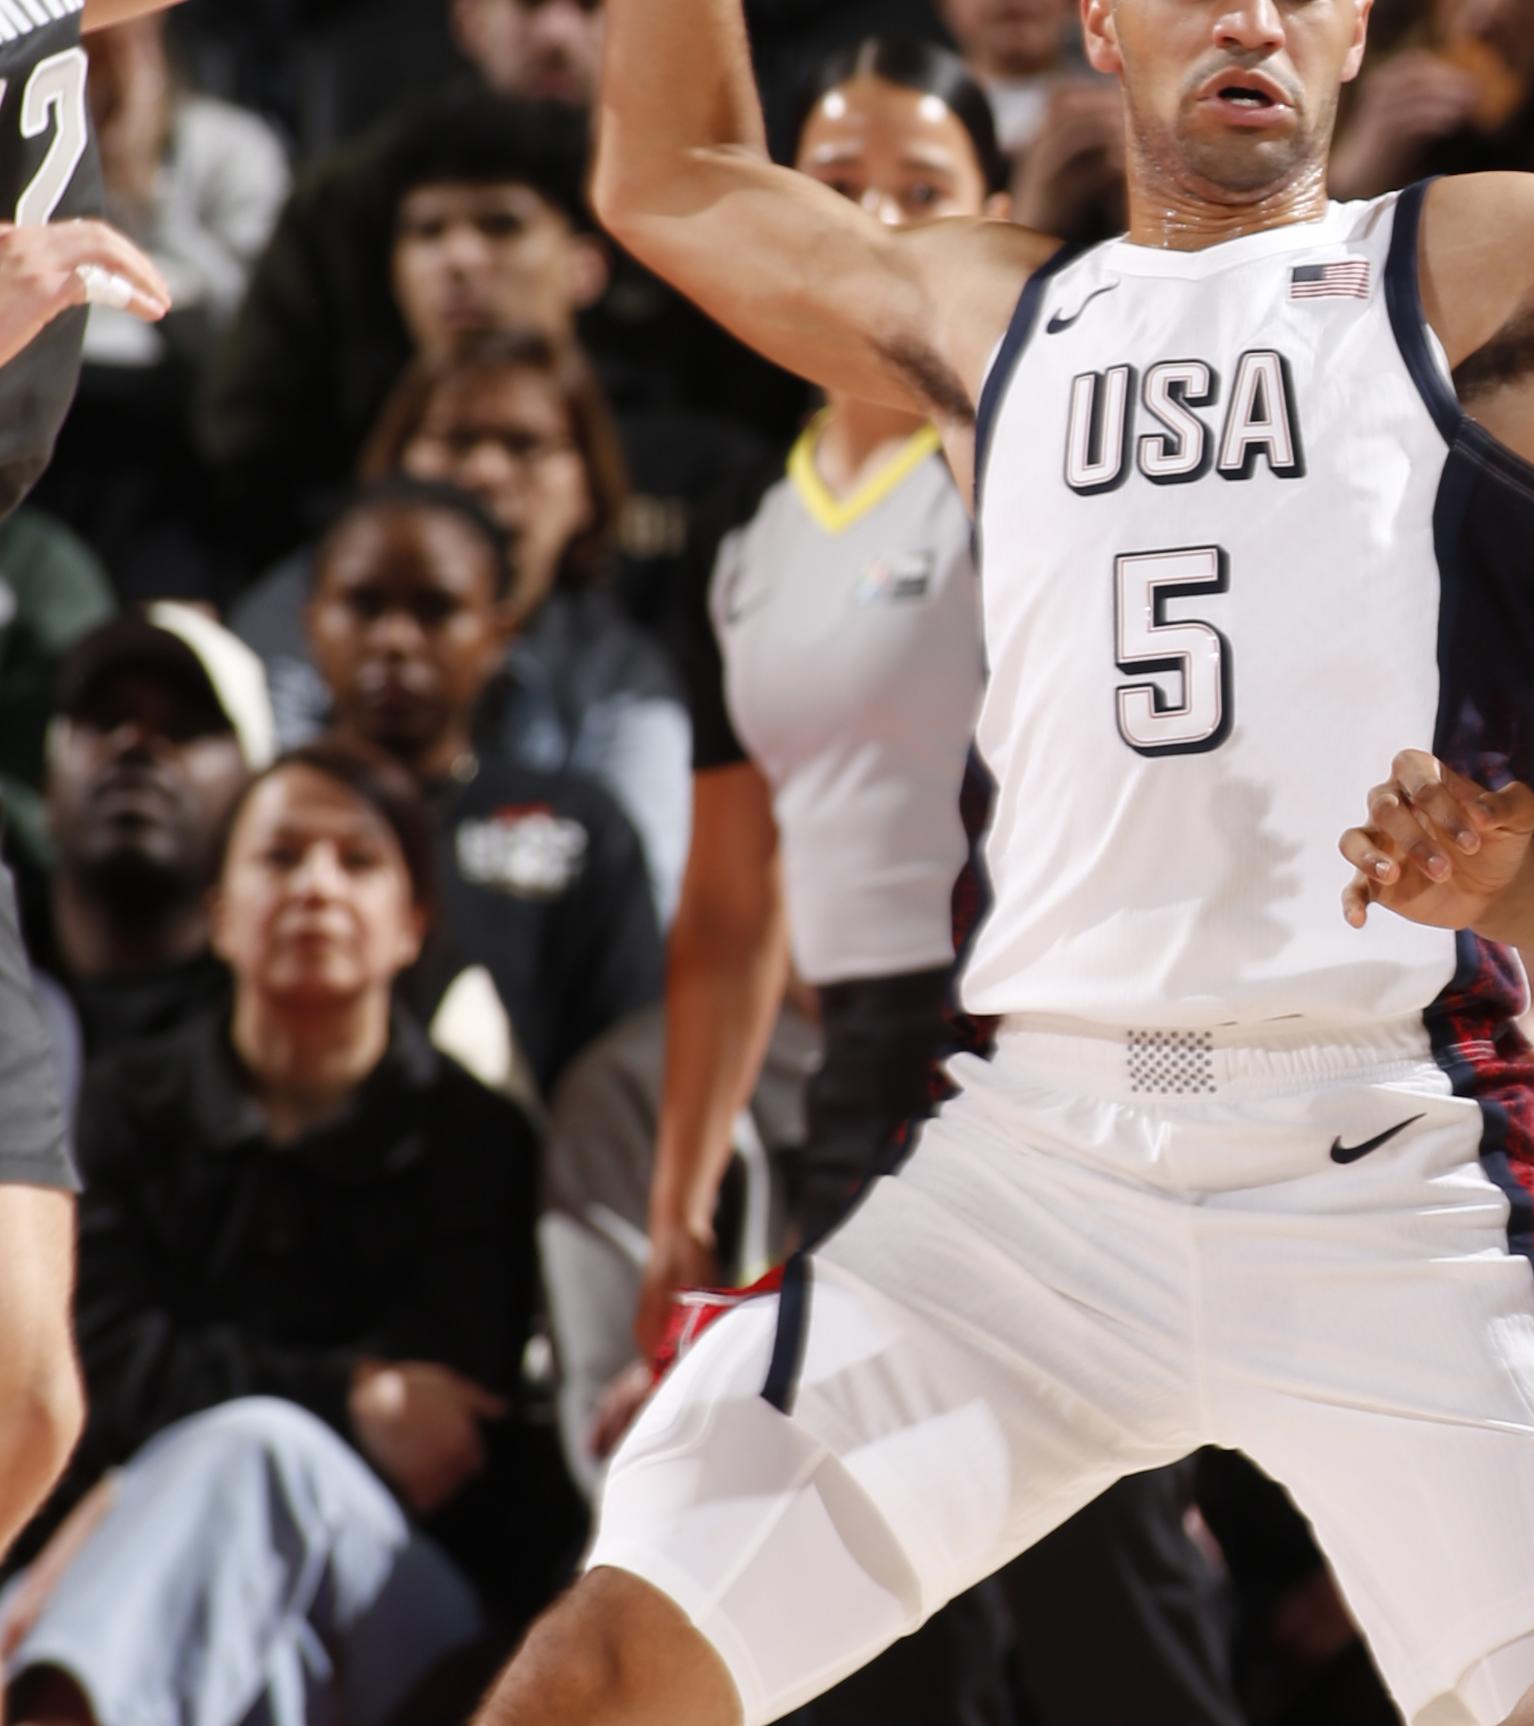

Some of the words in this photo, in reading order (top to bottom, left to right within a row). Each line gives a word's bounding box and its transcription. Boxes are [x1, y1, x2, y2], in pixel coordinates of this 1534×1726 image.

[0, 47, 88, 228] 2
[1064, 348, 1307, 496] USA
[1114, 544, 1235, 758] 5
